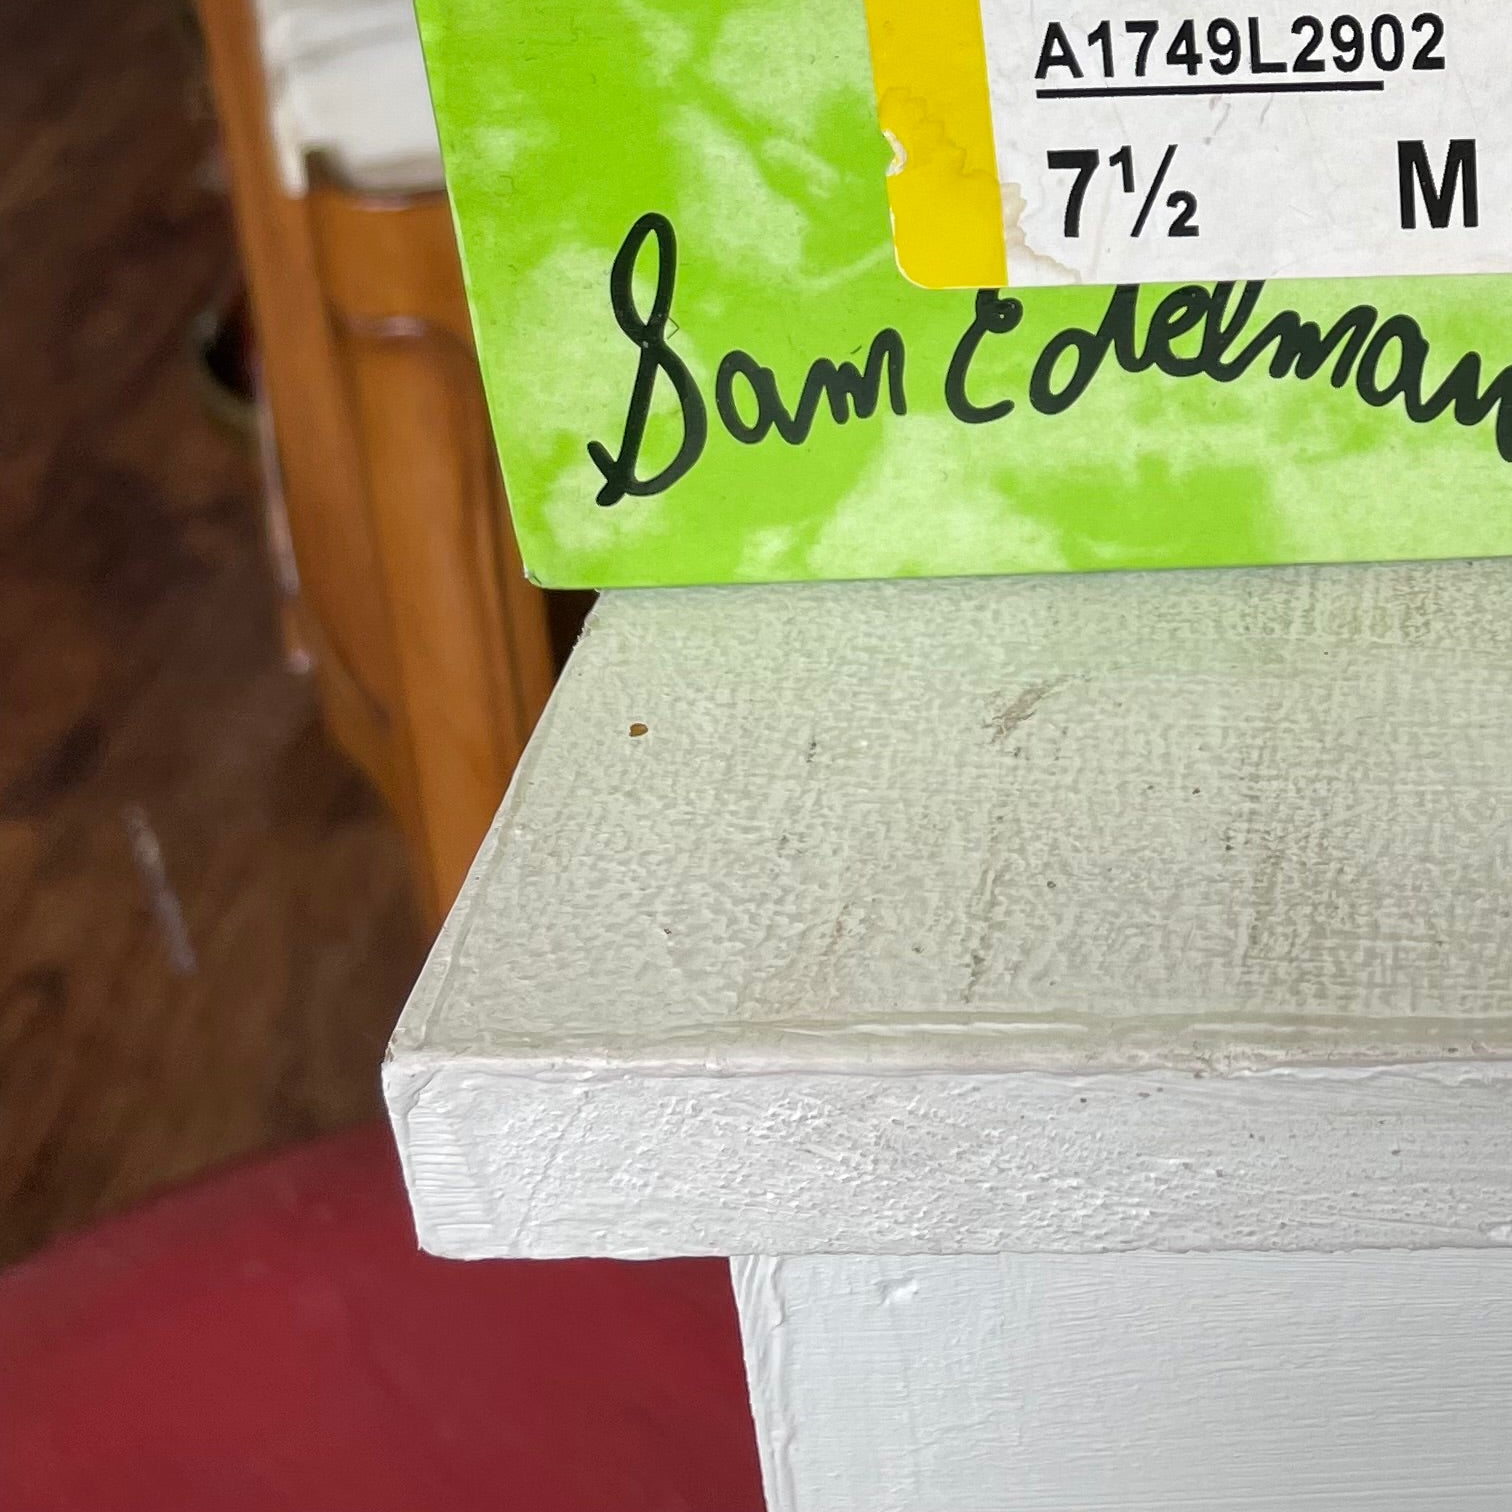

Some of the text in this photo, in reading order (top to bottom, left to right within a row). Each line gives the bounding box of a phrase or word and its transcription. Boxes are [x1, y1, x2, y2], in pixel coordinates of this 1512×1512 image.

[1034, 12, 1445, 80] A1749L2902
[1397, 138, 1480, 230] M
[586, 212, 907, 507] Sam
